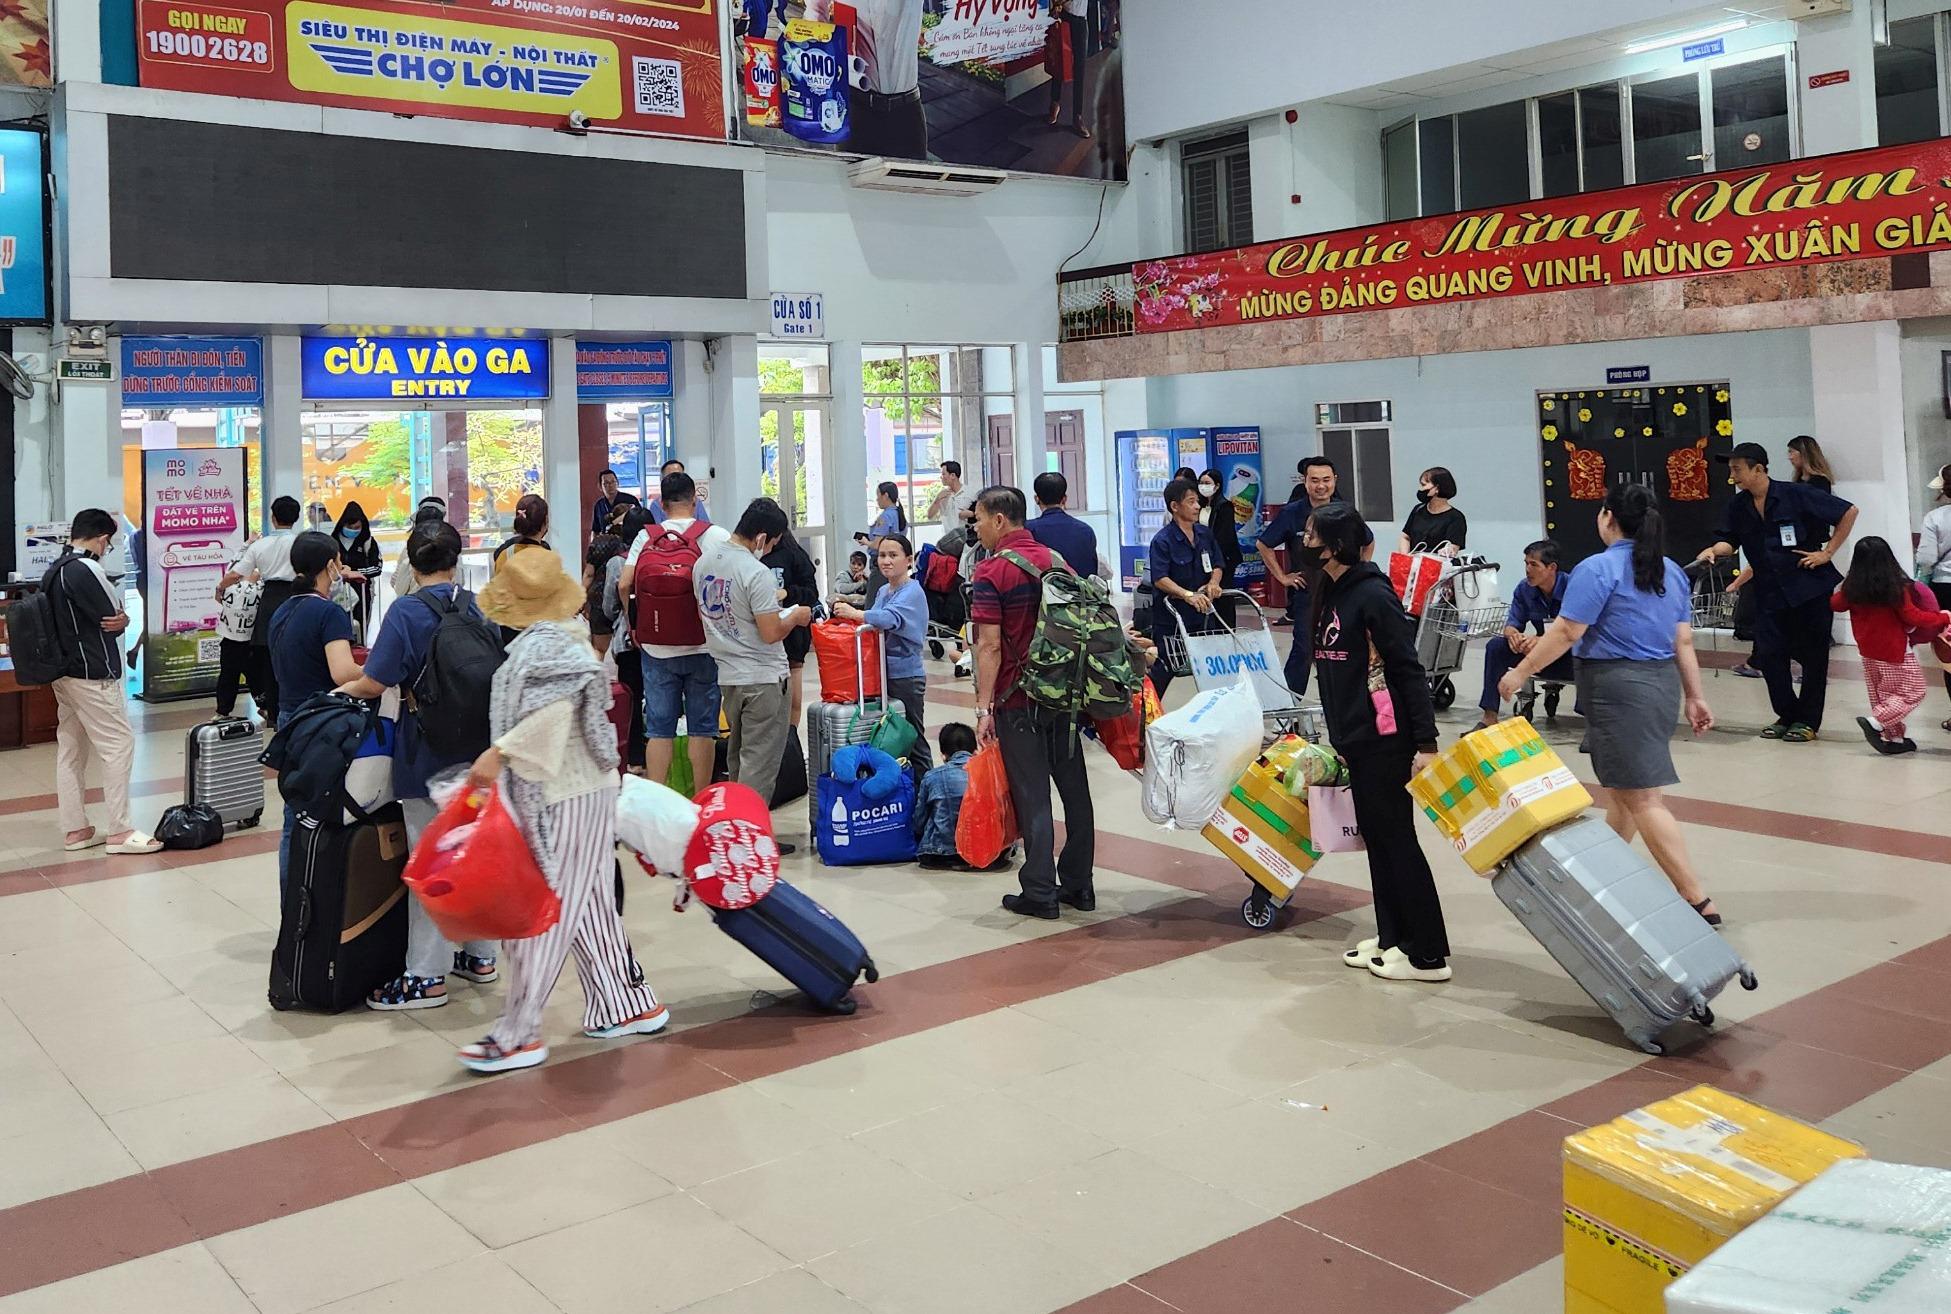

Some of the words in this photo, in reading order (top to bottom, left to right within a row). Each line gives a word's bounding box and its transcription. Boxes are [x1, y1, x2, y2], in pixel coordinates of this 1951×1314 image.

[168, 10, 199, 31] GỌI
[202, 15, 247, 35] NGAY
[513, 0, 553, 13] DỤNG:
[555, 5, 587, 18] 20/01
[589, 8, 614, 21] ĐẾN
[617, 13, 680, 31] 20/02/2024
[980, 26, 1000, 37] không
[147, 30, 205, 58] 1900
[208, 37, 268, 64] 2628
[301, 20, 347, 39] SIÊU
[354, 27, 388, 48] THỊ
[395, 33, 444, 53] ĐIỆN
[451, 37, 492, 56] MÁY
[513, 44, 547, 65] NỘI
[554, 47, 598, 68] THẤT
[940, 49, 960, 58] mang
[961, 47, 974, 57] một
[976, 43, 987, 54] Tết
[378, 52, 456, 93] CHỢ
[463, 59, 537, 92] LỚN
[801, 53, 835, 77] OMO
[752, 68, 777, 85] OMO
[807, 76, 832, 86] MATIC
[1266, 232, 1412, 277] Chúc
[1423, 207, 1645, 258] Mừng
[1671, 167, 1926, 223] Năm
[1240, 288, 1312, 319] MỪNG
[1320, 277, 1397, 311] ĐẢNG
[1405, 265, 1513, 301] QUANG
[1522, 254, 1611, 288] VINH,
[1623, 239, 1733, 277] MỪNG
[1747, 220, 1860, 264] XUÂN
[773, 294, 796, 320] CỬA
[798, 295, 812, 320] SỐ
[815, 300, 821, 319] 1
[783, 323, 805, 334] Gate
[808, 324, 813, 333] 1
[71, 362, 100, 371] EXIT
[133, 348, 162, 367] NGƯỜI
[164, 349, 189, 367] THÂN
[191, 350, 201, 367] ĐI
[225, 346, 245, 367] TIỄN
[323, 337, 399, 375] CỬA
[407, 341, 477, 375] VÀO
[485, 347, 532, 375] GA
[123, 372, 148, 393] DỪNG
[151, 372, 181, 393] TRƯỚC
[183, 371, 208, 392] CỔNG
[209, 371, 232, 392] KIỂM
[233, 373, 257, 392] SOÁT
[391, 379, 471, 396] ENTRY
[1217, 441, 1259, 455] LIPOVITAN
[156, 486, 182, 501] TẾT
[183, 485, 202, 500] VỀ
[204, 485, 233, 499] NHÀ
[201, 504, 226, 514] TRÊN
[161, 517, 198, 527] MOMO
[852, 802, 903, 821] POCARI
[1621, 1246, 1659, 1271] FRAGILE
